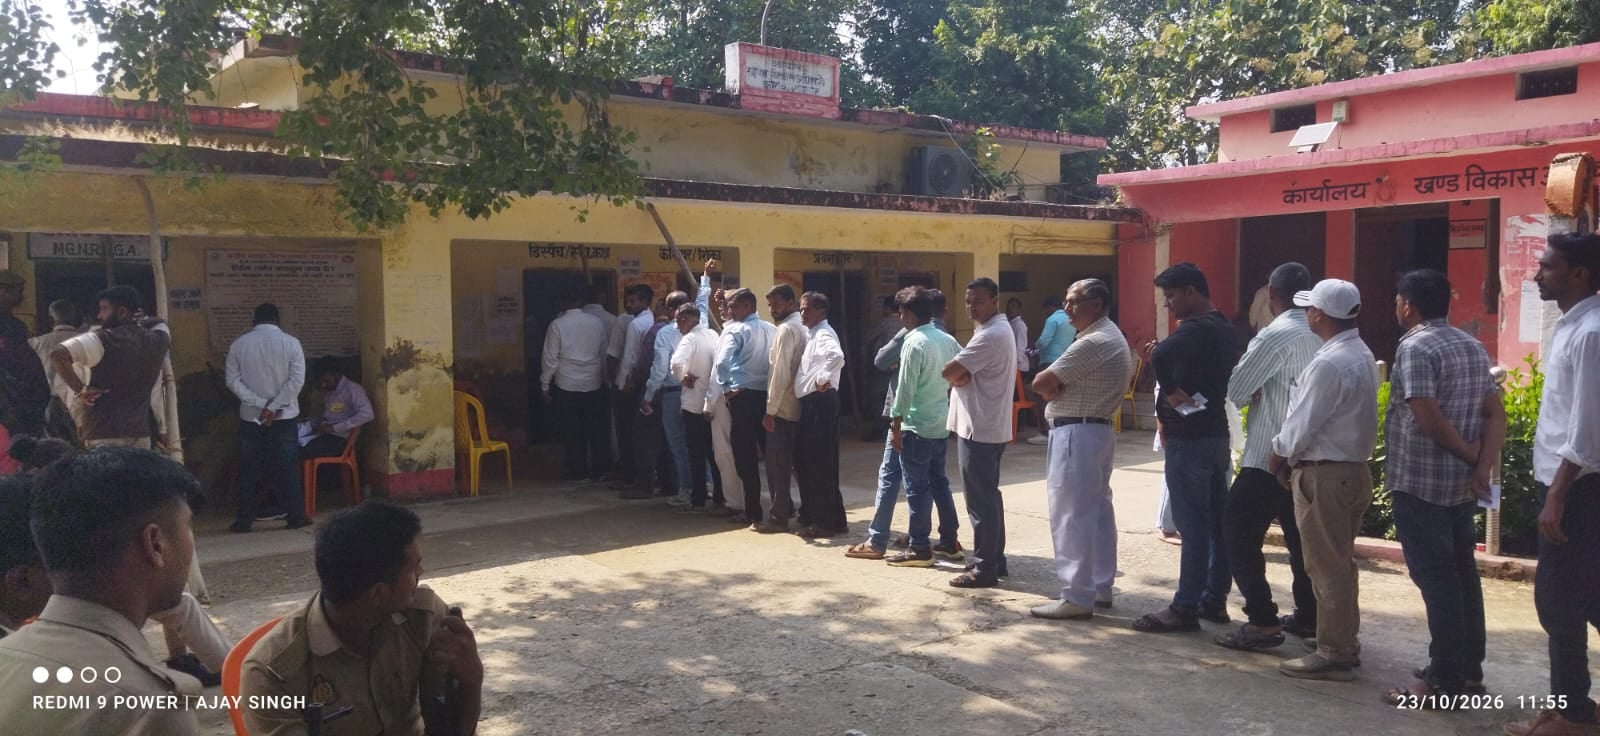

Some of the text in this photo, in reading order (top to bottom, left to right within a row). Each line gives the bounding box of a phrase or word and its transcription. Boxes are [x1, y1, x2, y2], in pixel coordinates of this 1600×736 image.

[1282, 179, 1370, 204] कार्यालय
[1414, 174, 1460, 194] खण्ड
[1465, 164, 1538, 191] विकास
